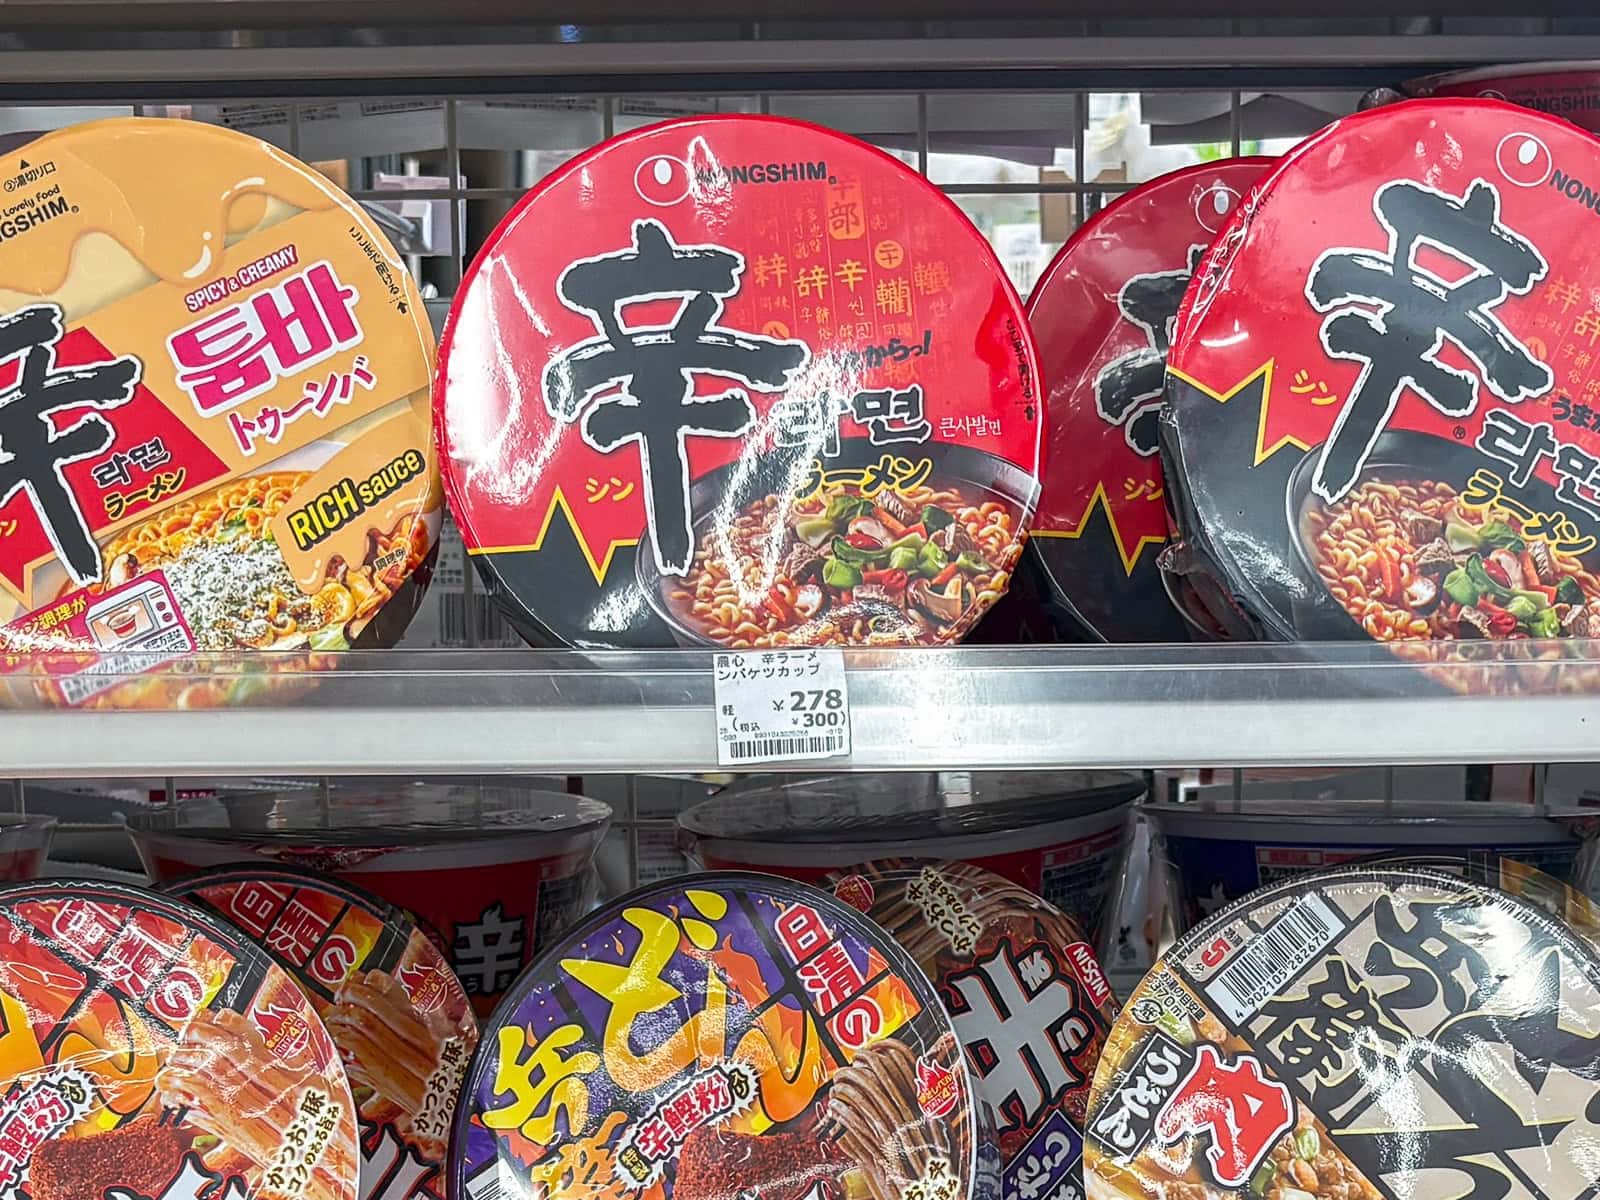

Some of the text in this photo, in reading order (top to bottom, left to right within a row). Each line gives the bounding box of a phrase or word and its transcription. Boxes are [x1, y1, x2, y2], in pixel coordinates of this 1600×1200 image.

[185, 279, 229, 312] SPICY
[239, 246, 298, 287] CREAMY
[1306, 181, 1551, 502] 辛
[227, 355, 376, 456] トゥーンバ
[550, 222, 807, 574] 辛
[1290, 369, 1337, 405] シン
[93, 436, 171, 488] 라면
[105, 467, 187, 521] ラーメン
[586, 476, 635, 504] シン
[792, 455, 934, 497] ラーメン
[292, 449, 424, 550] RICH sauce
[1461, 470, 1597, 556] ラーメン
[774, 904, 887, 1052] 日清の
[1072, 945, 1106, 997] NISSIN
